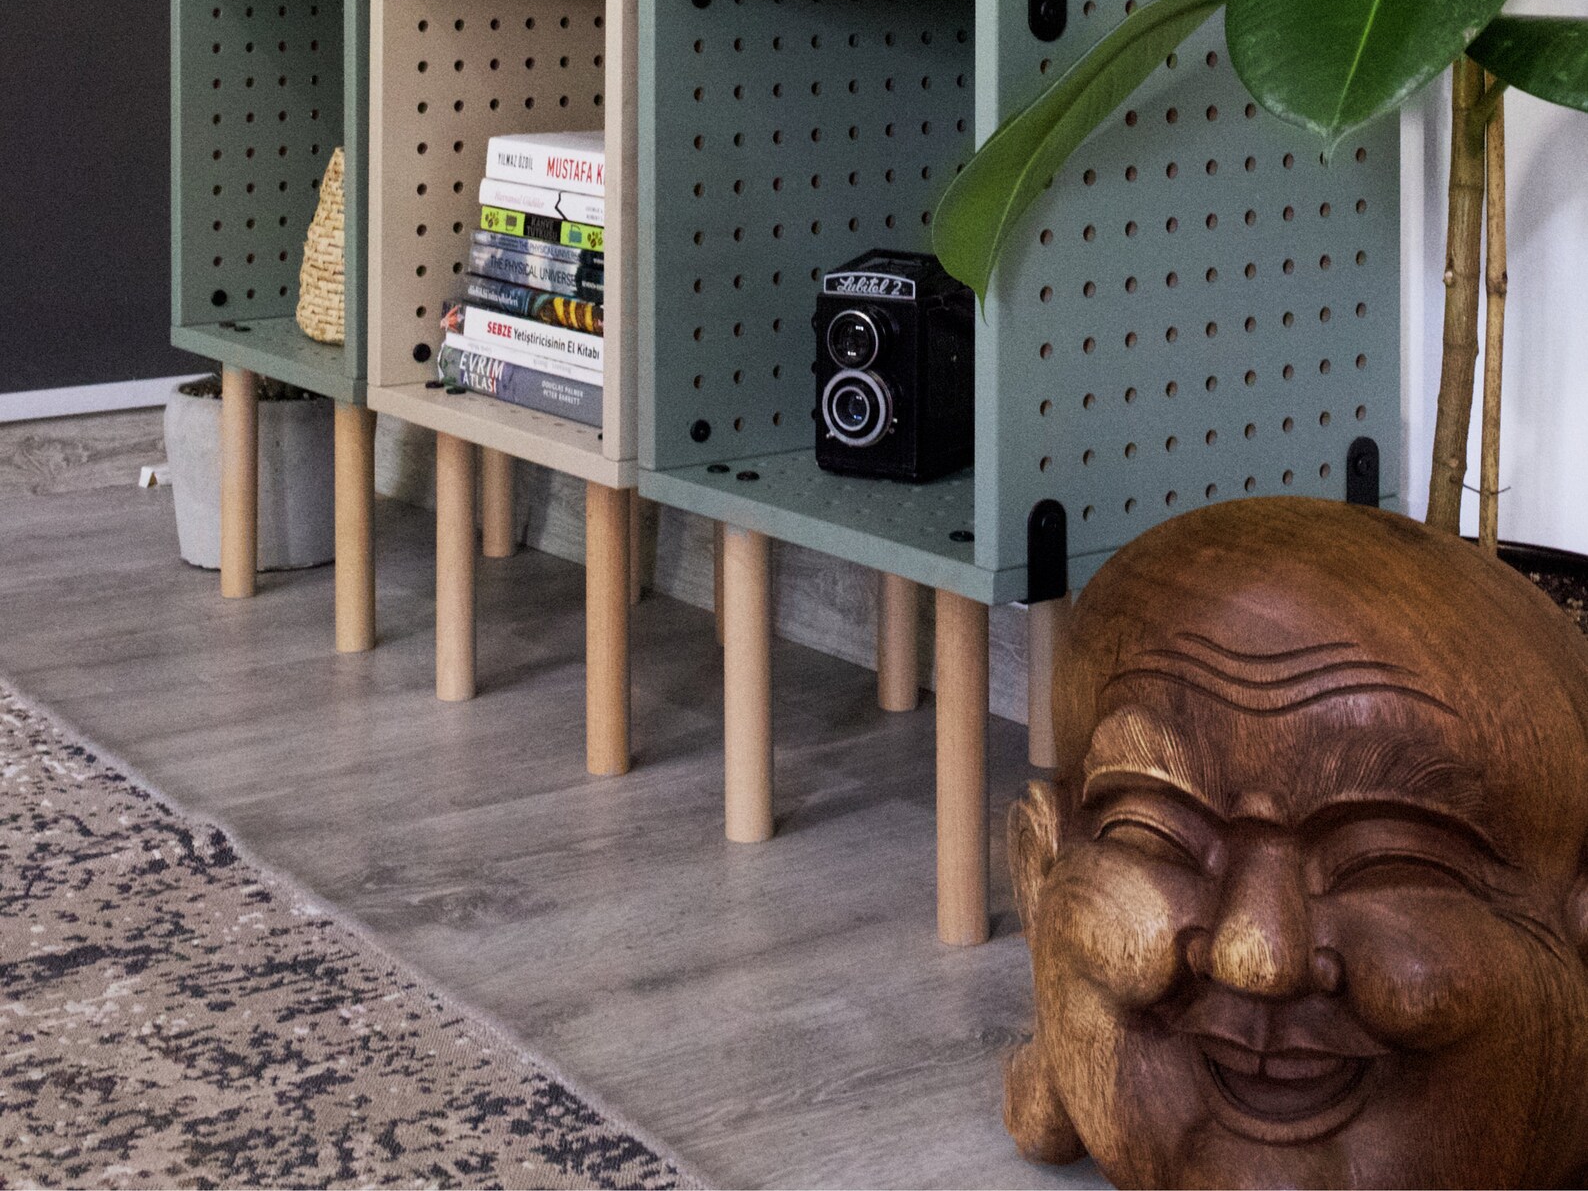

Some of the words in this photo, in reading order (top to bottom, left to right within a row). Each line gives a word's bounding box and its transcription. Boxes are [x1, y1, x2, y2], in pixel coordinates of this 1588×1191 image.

[498, 153, 518, 168] YILMAZ
[547, 157, 592, 184] MUSTAFA
[597, 163, 605, 185] K
[490, 255, 503, 269] THE
[503, 257, 538, 279] PHYSICAL
[539, 266, 577, 288] UNIVERSE
[837, 276, 889, 295] Lubitel
[891, 280, 902, 295] 2
[487, 321, 513, 339] SEBZE
[513, 329, 566, 352] Yetiştiricisinin
[567, 340, 576, 354] El
[577, 343, 601, 360] Kitabı
[461, 372, 497, 394] ATLASI
